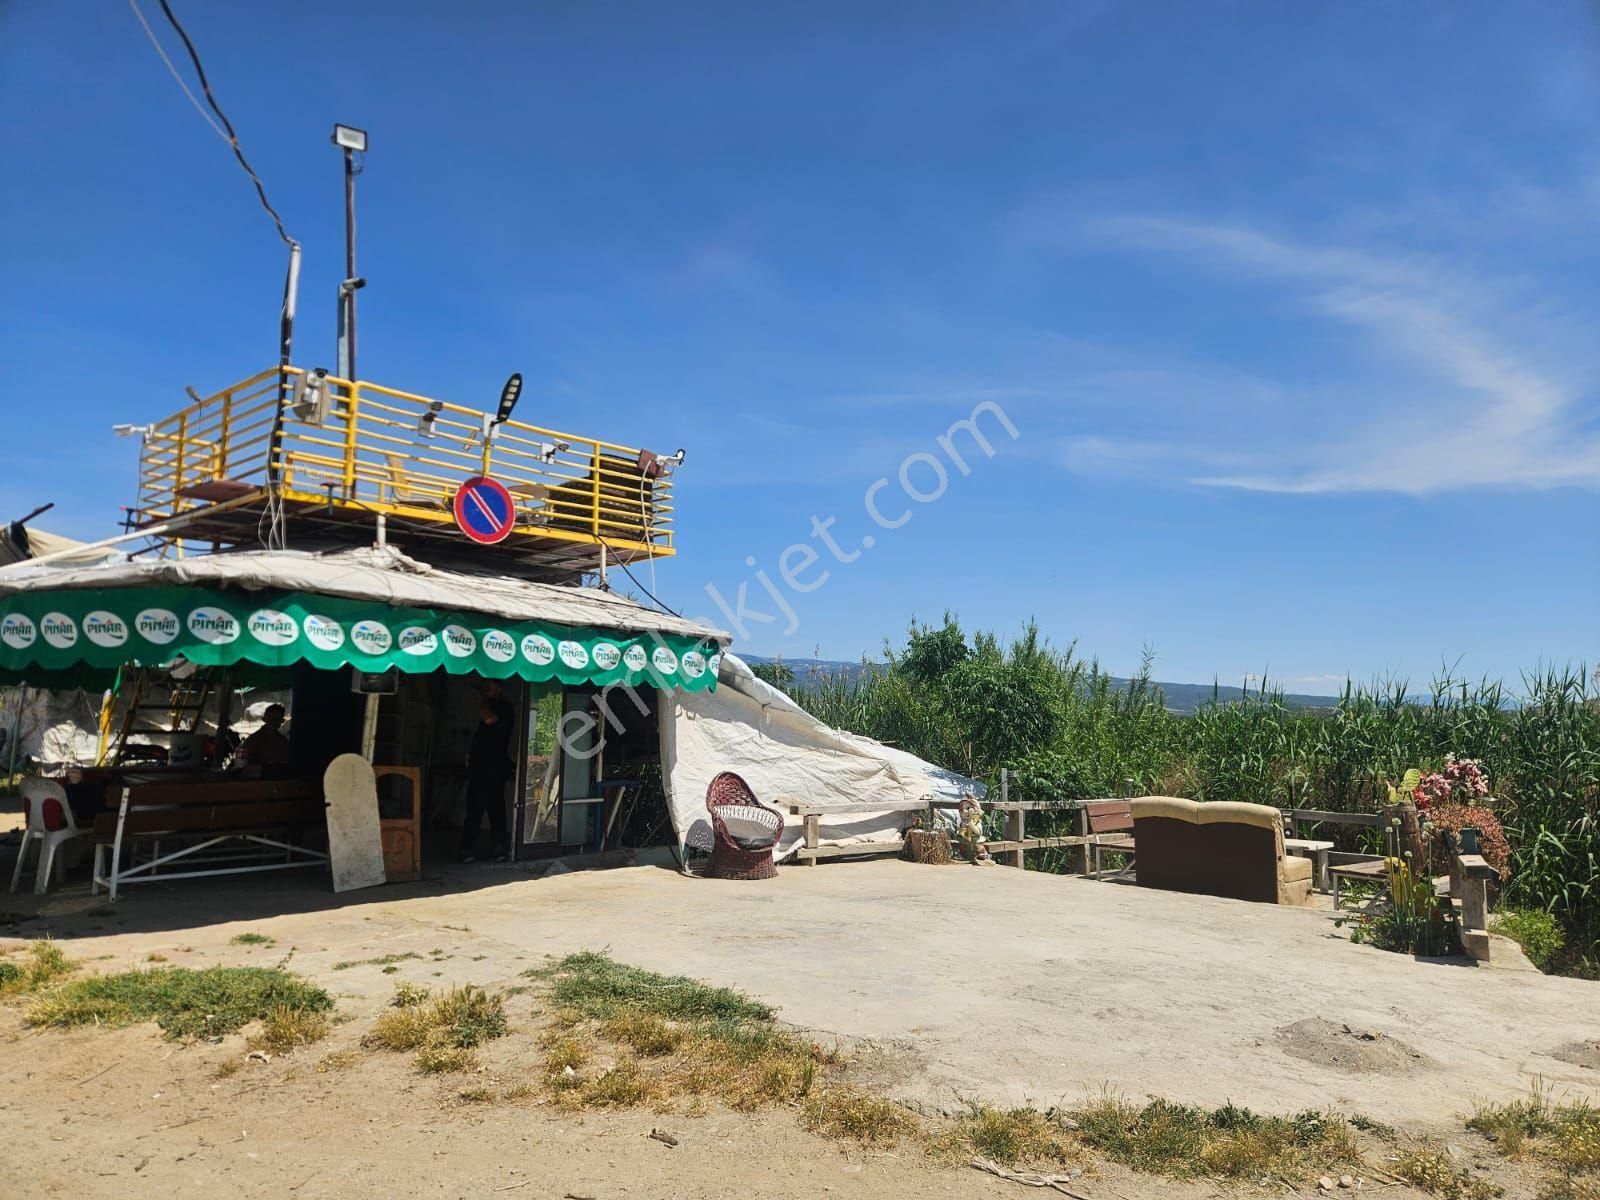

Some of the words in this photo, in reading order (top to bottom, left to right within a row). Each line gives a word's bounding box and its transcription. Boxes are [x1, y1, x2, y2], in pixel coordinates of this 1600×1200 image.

[3, 623, 32, 635] PINAR
[87, 621, 122, 634] PINAR
[191, 618, 234, 631] PINAR
[253, 620, 293, 631] PINAR
[486, 639, 513, 652] PINAR
[524, 643, 552, 655] PINAR
